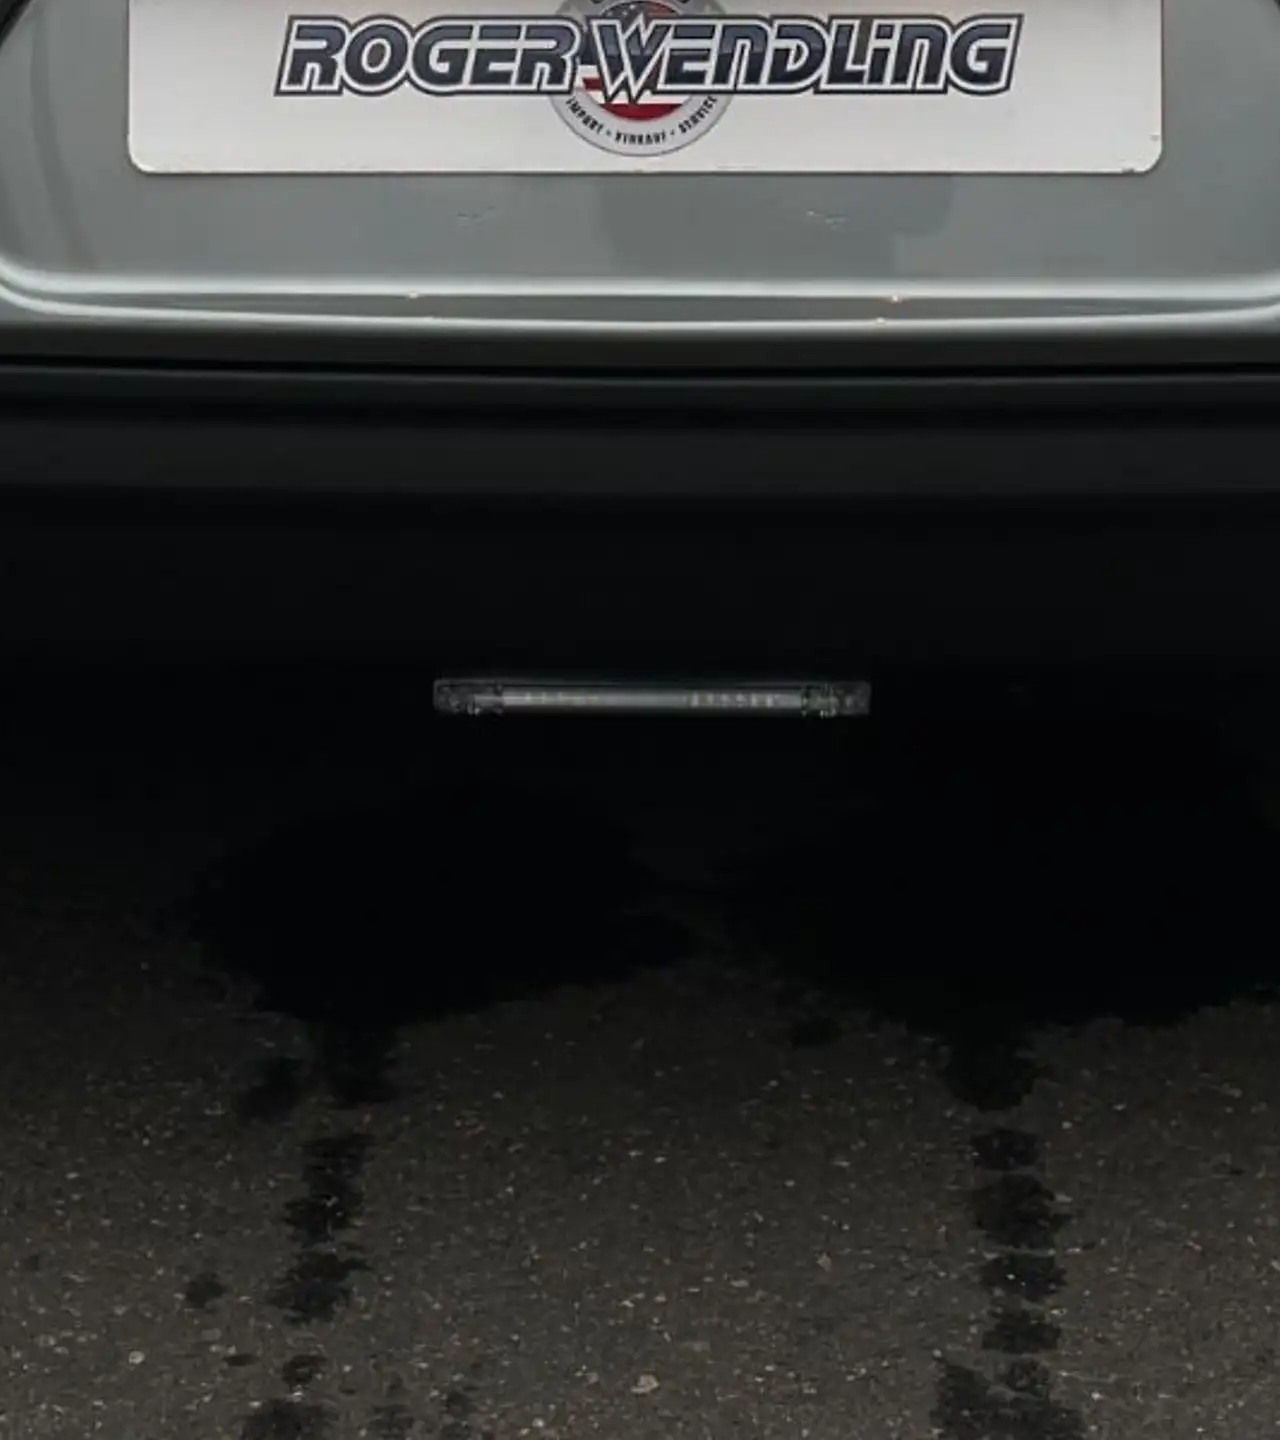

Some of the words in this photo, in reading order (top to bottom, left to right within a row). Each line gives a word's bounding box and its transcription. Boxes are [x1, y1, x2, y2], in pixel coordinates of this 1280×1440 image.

[274, 14, 584, 97] ROGER
[586, 13, 1025, 105] WENDLING
[565, 95, 604, 134] IMPORT
[677, 94, 718, 134] SERVICE
